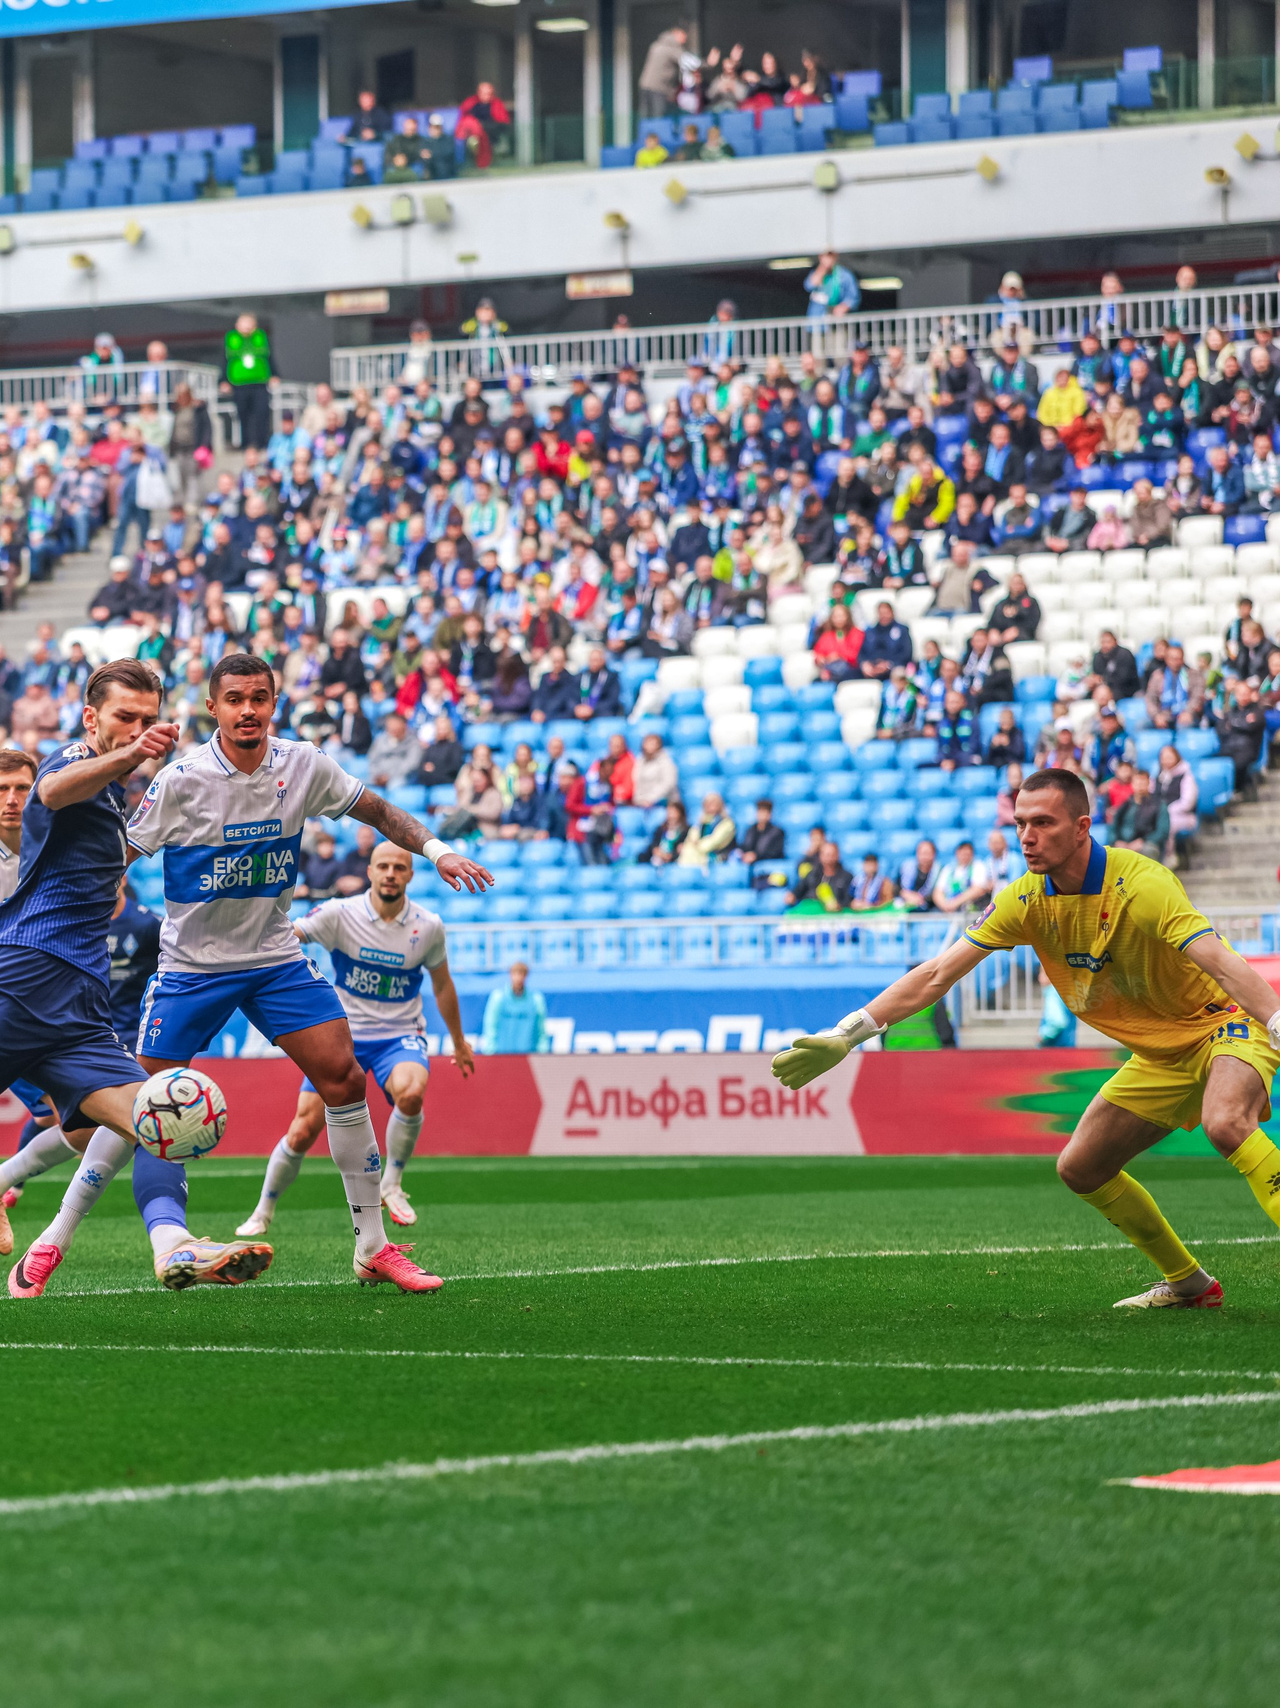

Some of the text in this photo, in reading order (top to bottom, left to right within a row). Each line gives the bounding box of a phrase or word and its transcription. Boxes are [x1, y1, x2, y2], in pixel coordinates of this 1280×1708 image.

[225, 823, 280, 839] БЕТСИТИ
[213, 849, 295, 874] EKONIVA
[199, 868, 288, 891] ЭКОНИВА
[352, 965, 411, 987] EKONIVA
[565, 1076, 829, 1129] Альфа Банк
